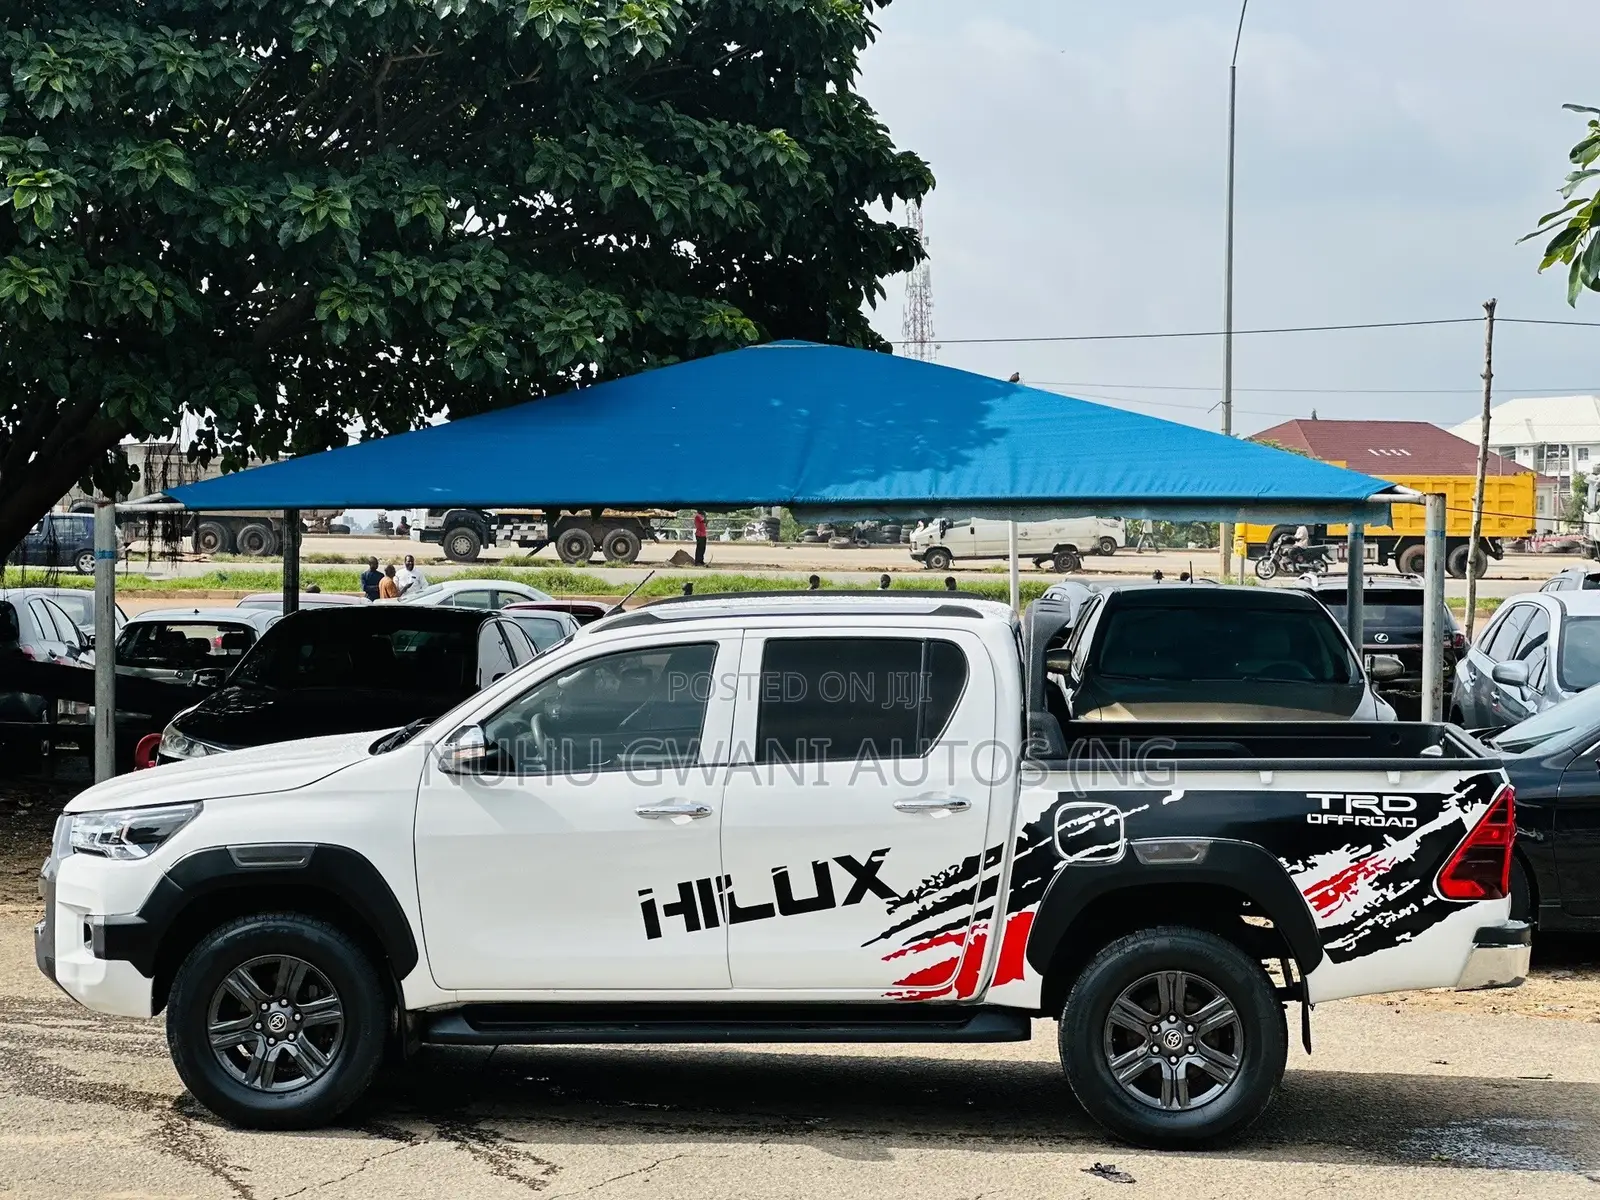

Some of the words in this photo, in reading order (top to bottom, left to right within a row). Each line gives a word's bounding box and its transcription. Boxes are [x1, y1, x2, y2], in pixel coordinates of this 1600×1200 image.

[1306, 793, 1418, 816] TRD
[1306, 813, 1418, 828] OFFROAD
[637, 847, 900, 941] HILUX
